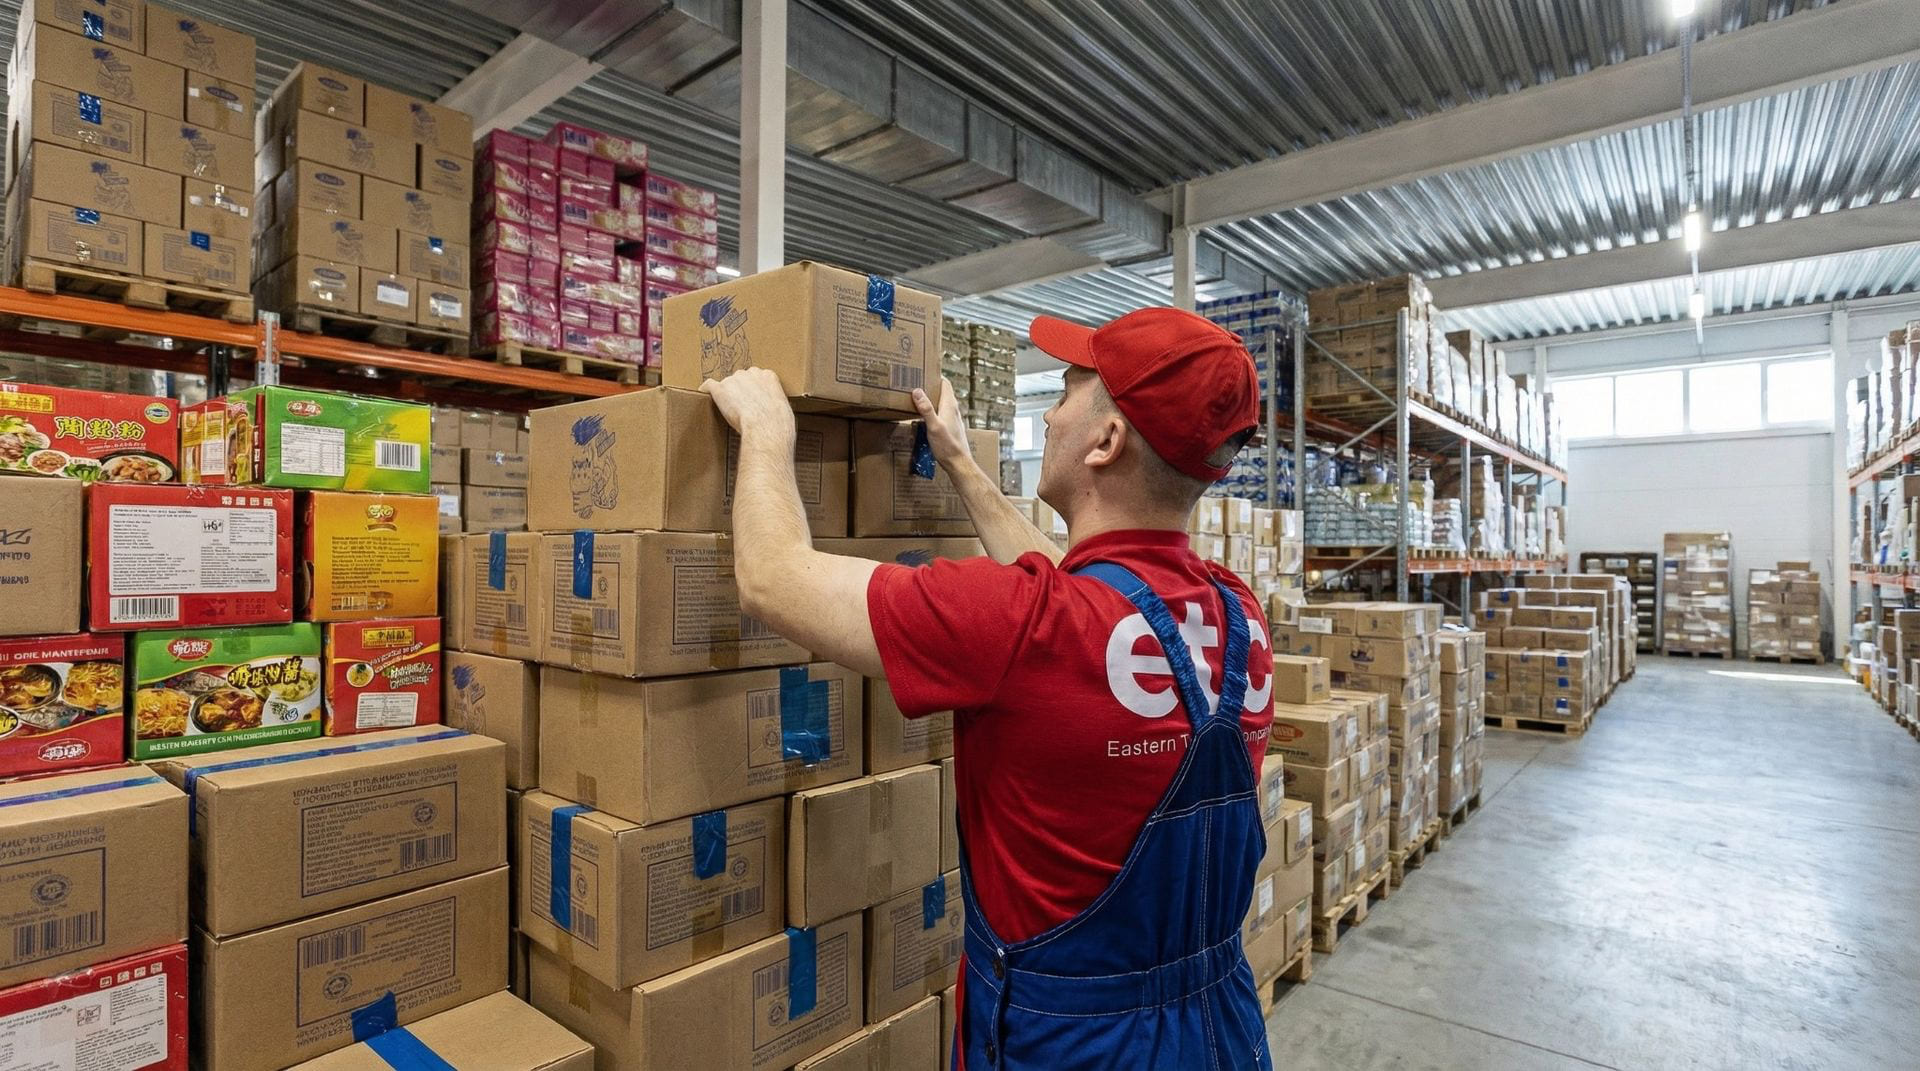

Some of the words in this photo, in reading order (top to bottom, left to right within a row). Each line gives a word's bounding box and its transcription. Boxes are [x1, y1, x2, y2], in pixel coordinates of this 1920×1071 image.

[1106, 601, 1272, 718] etc
[1107, 738, 1177, 757] Eastern
[1242, 723, 1272, 745] ompany
